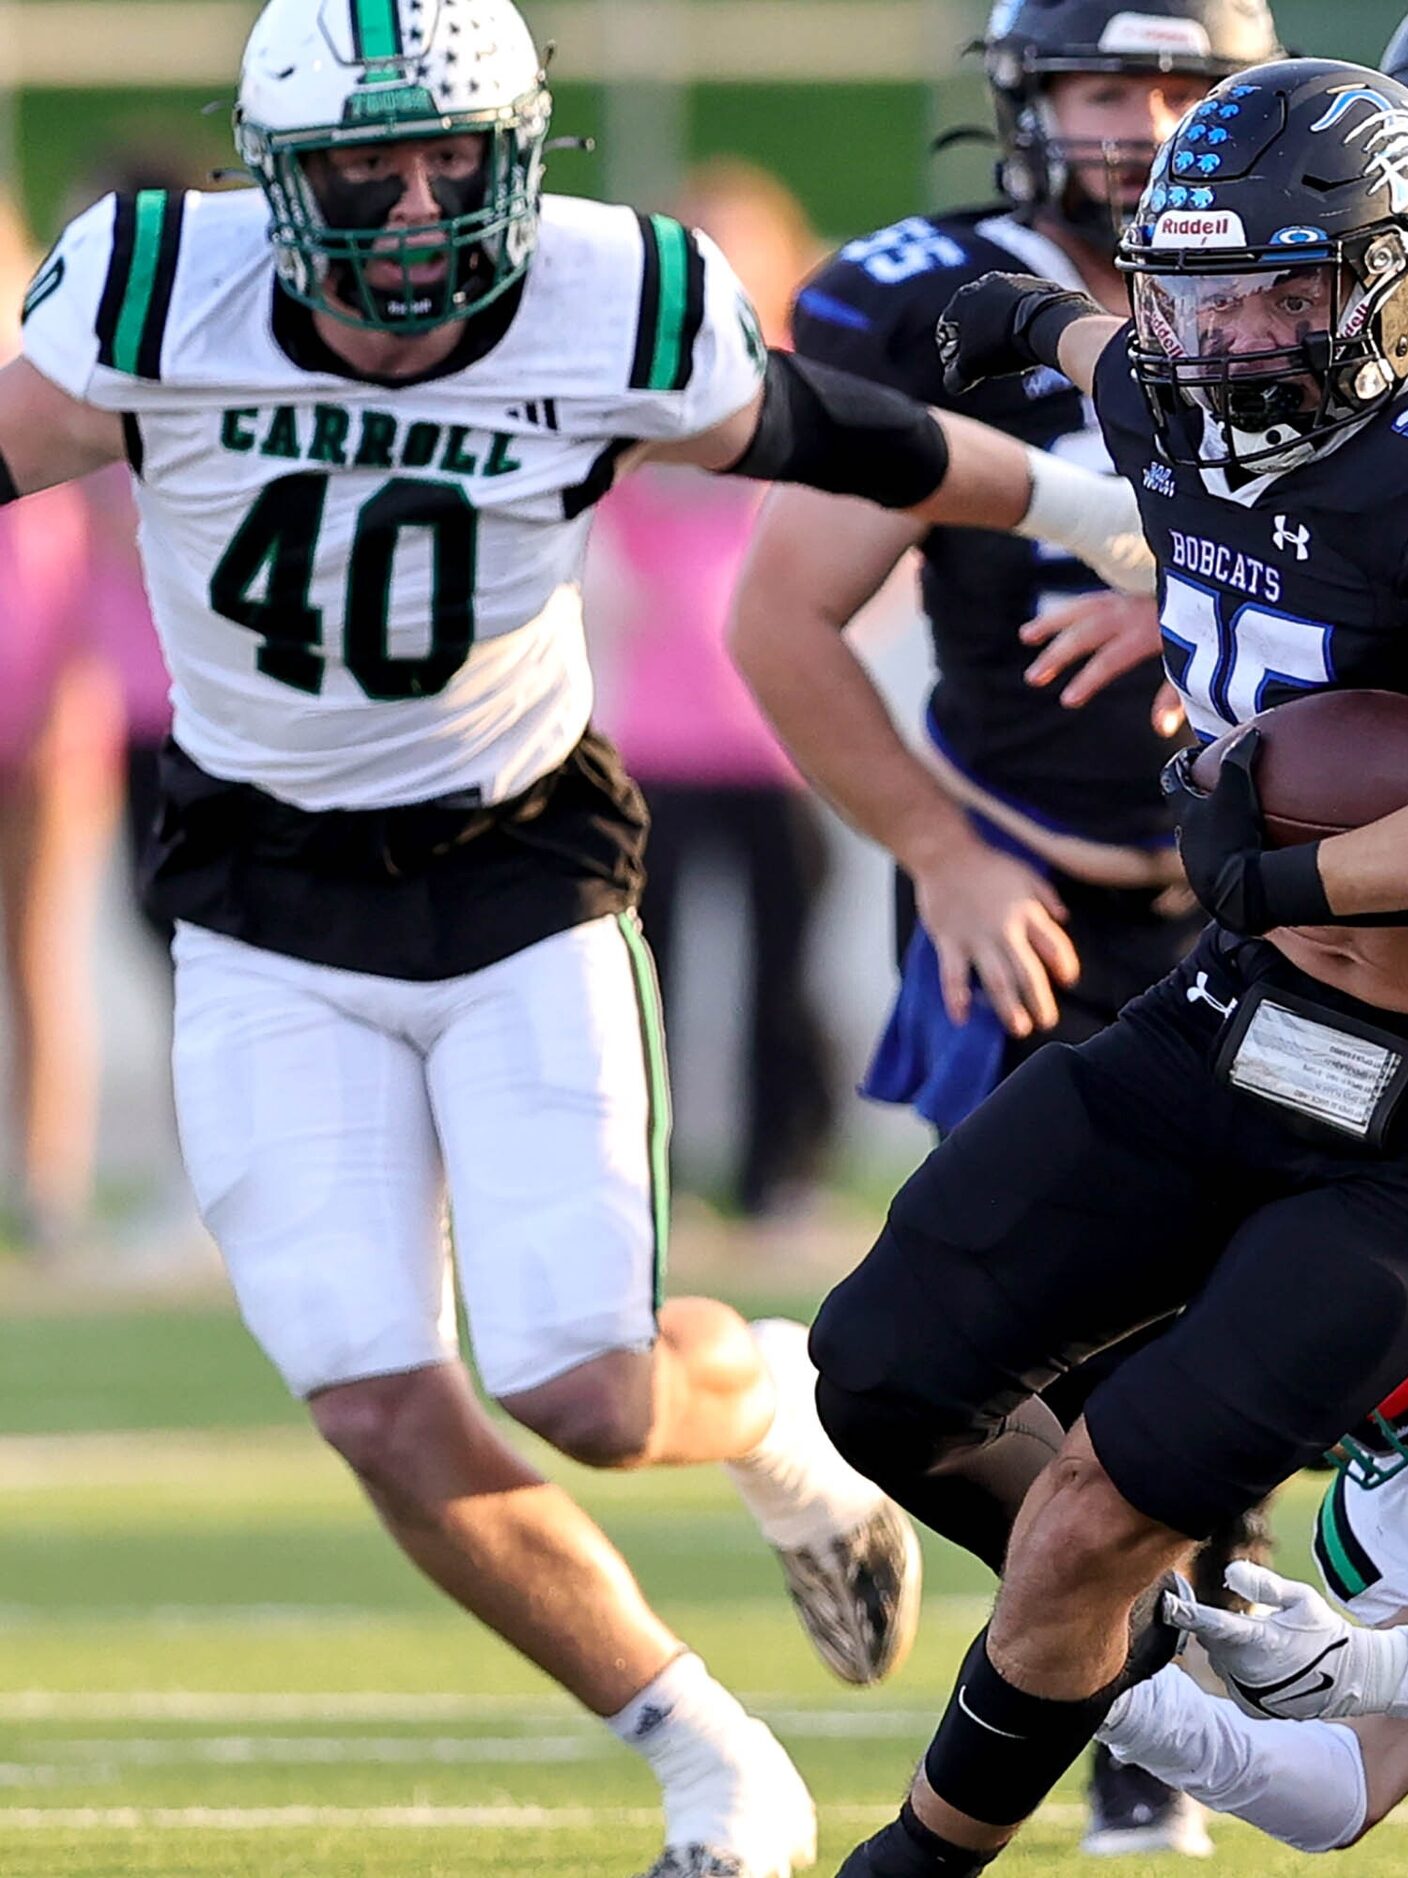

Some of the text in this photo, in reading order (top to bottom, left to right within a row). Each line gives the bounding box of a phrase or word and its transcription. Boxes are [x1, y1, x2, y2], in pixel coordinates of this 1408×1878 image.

[1162, 218, 1229, 235] Riddell
[221, 403, 522, 477] CARROLL
[209, 472, 478, 700] 40
[1168, 528, 1281, 603] BOBCATS
